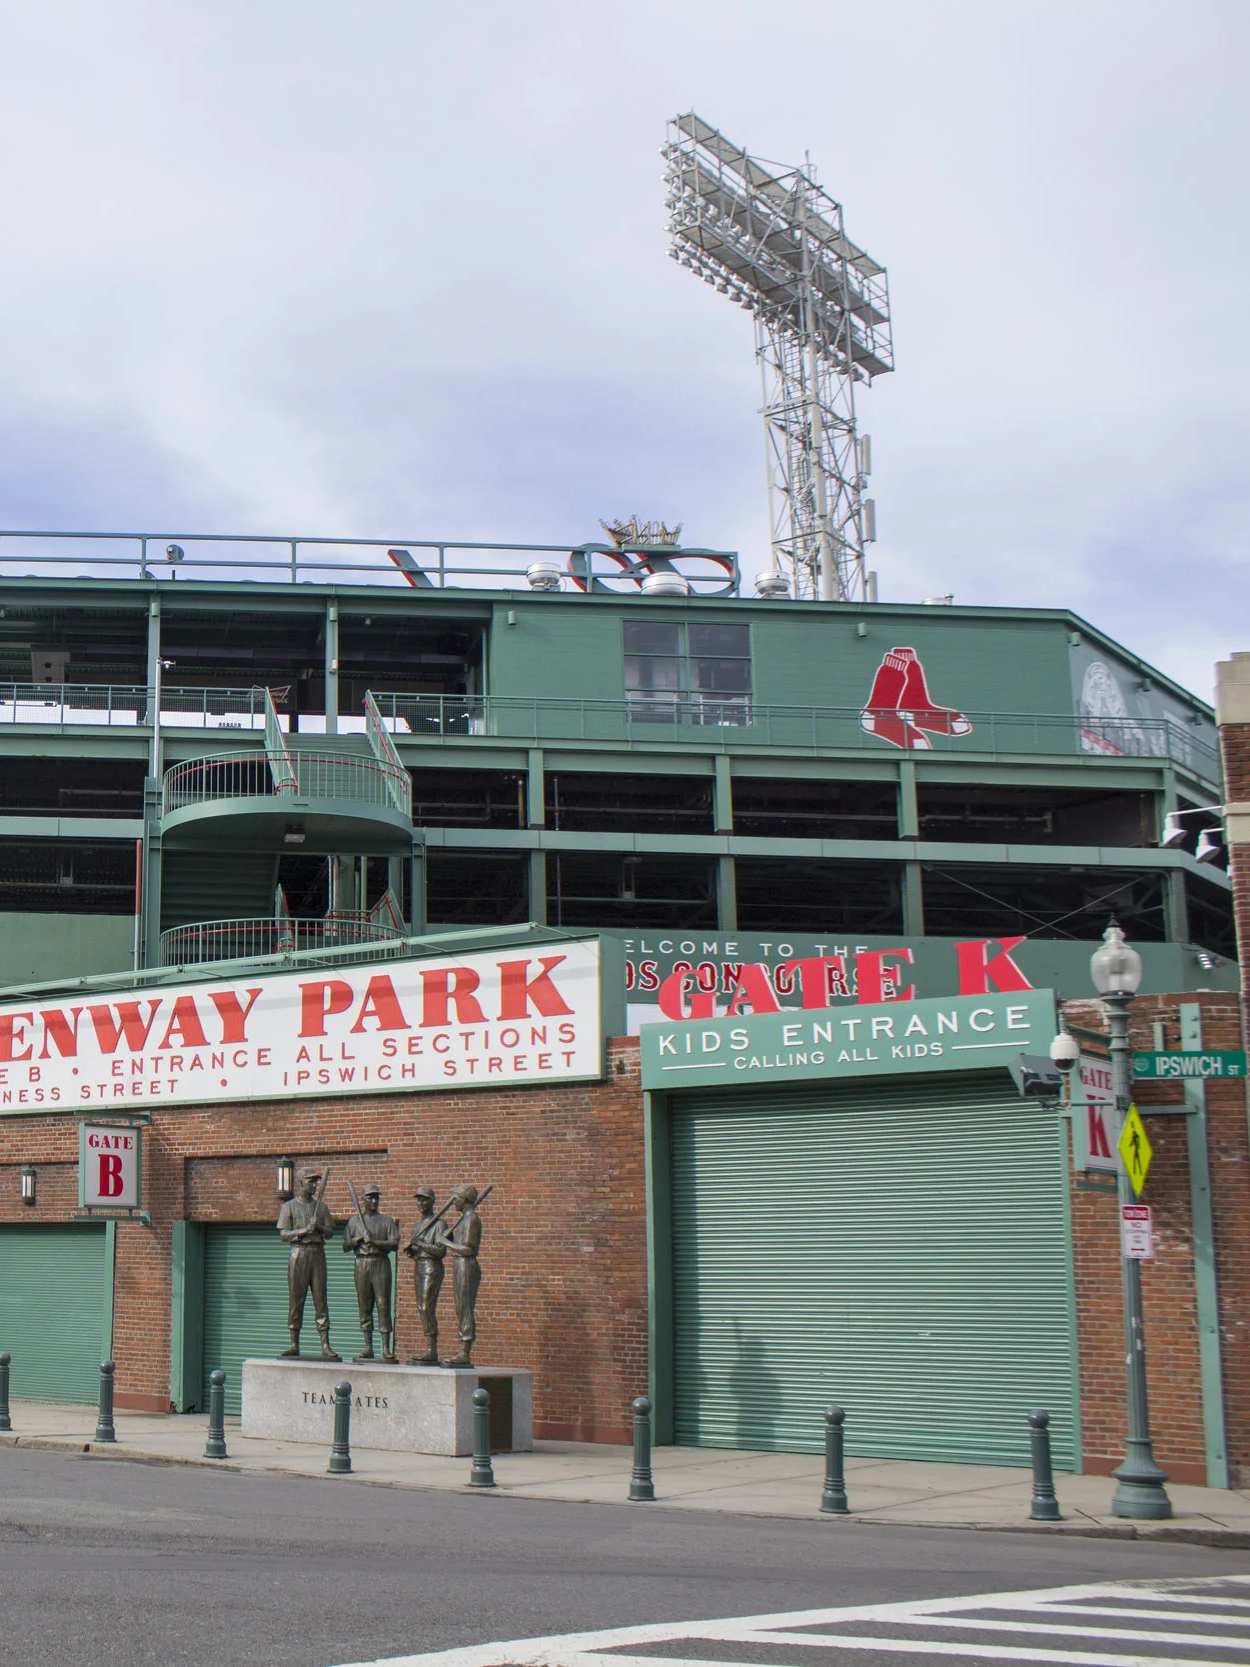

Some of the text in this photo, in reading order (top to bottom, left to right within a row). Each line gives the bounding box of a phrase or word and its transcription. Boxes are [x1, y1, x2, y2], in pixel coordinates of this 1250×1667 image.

[759, 943, 794, 957] TO
[298, 955, 575, 1038] PARK
[658, 935, 1036, 1021] GATE K
[29, 1066, 41, 1082] B
[112, 1048, 272, 1077] ENTRANCE
[296, 1042, 356, 1064] ALL
[382, 1023, 576, 1057] SECTIONS
[659, 1005, 1032, 1056] KIDS ENTRANCE
[3, 1087, 61, 1104] NESS
[80, 1079, 178, 1100] STREET
[283, 1063, 416, 1086] IPSWICH
[443, 1051, 576, 1076] STREET
[734, 1042, 944, 1070] CALLING ALL KIDS
[1080, 1066, 1112, 1090] GATE
[1155, 1056, 1240, 1076] IPSWICH ST
[88, 1134, 134, 1150] GATE
[1086, 1094, 1111, 1158] K
[97, 1153, 124, 1198] B
[302, 1391, 389, 1409] TEAMATES
